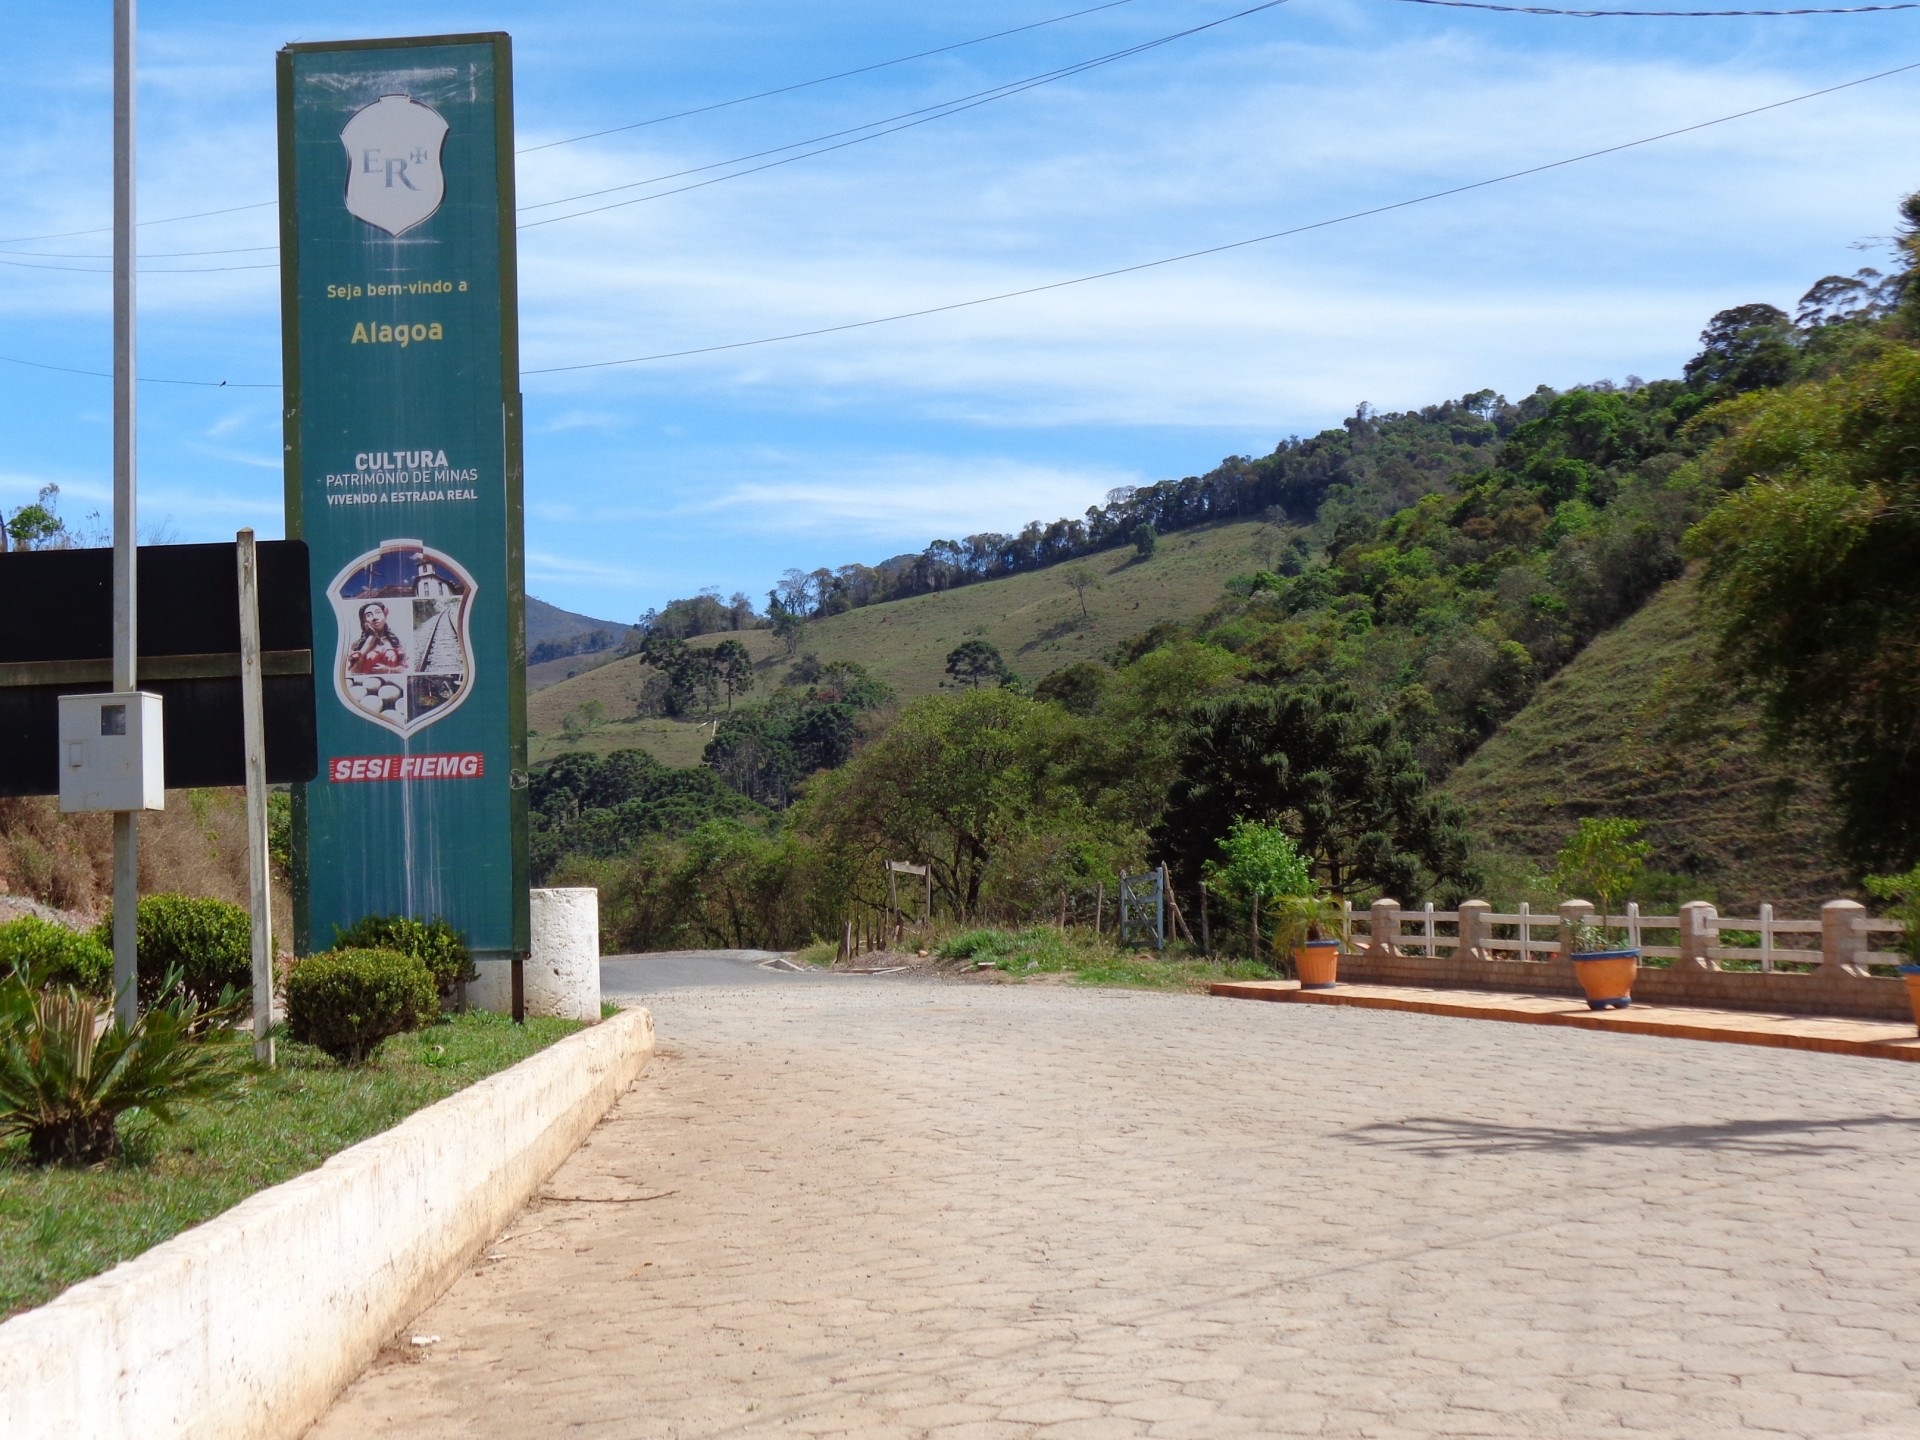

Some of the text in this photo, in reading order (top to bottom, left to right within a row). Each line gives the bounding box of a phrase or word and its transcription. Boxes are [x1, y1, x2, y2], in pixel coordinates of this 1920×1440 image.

[327, 280, 468, 300] Seja bem-vindo a
[351, 321, 443, 348] Alagoa
[355, 450, 449, 471] CULTURA
[326, 468, 478, 487] PATRIMÔNIO DE MINAS
[327, 489, 478, 505] VIVENDO A ESTRADA REAL
[334, 755, 478, 780] SESI FIEMG
